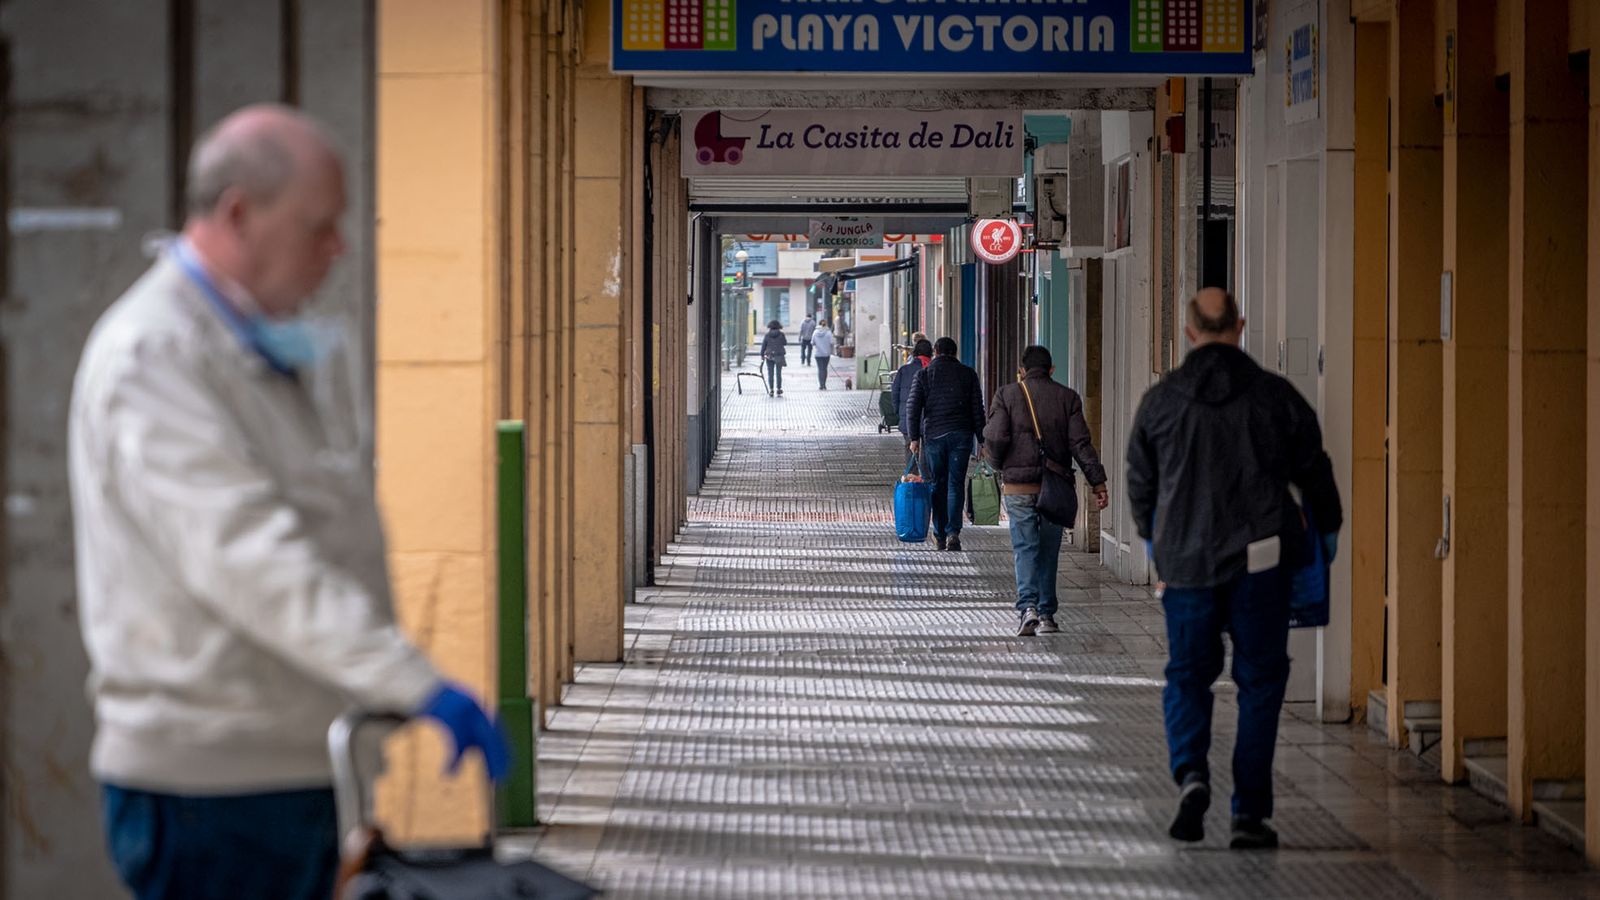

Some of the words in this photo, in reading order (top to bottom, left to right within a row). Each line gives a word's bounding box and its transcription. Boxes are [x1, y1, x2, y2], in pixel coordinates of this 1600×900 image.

[751, 13, 880, 51] PLAYA
[891, 14, 1115, 52] VICTORIA
[756, 124, 795, 149] La
[802, 123, 901, 149] Casita
[907, 121, 944, 149] de
[950, 121, 1015, 149] Dali
[820, 222, 833, 233] LA
[836, 222, 873, 235] JUNGLA
[819, 238, 874, 246] ACCESORIOS
